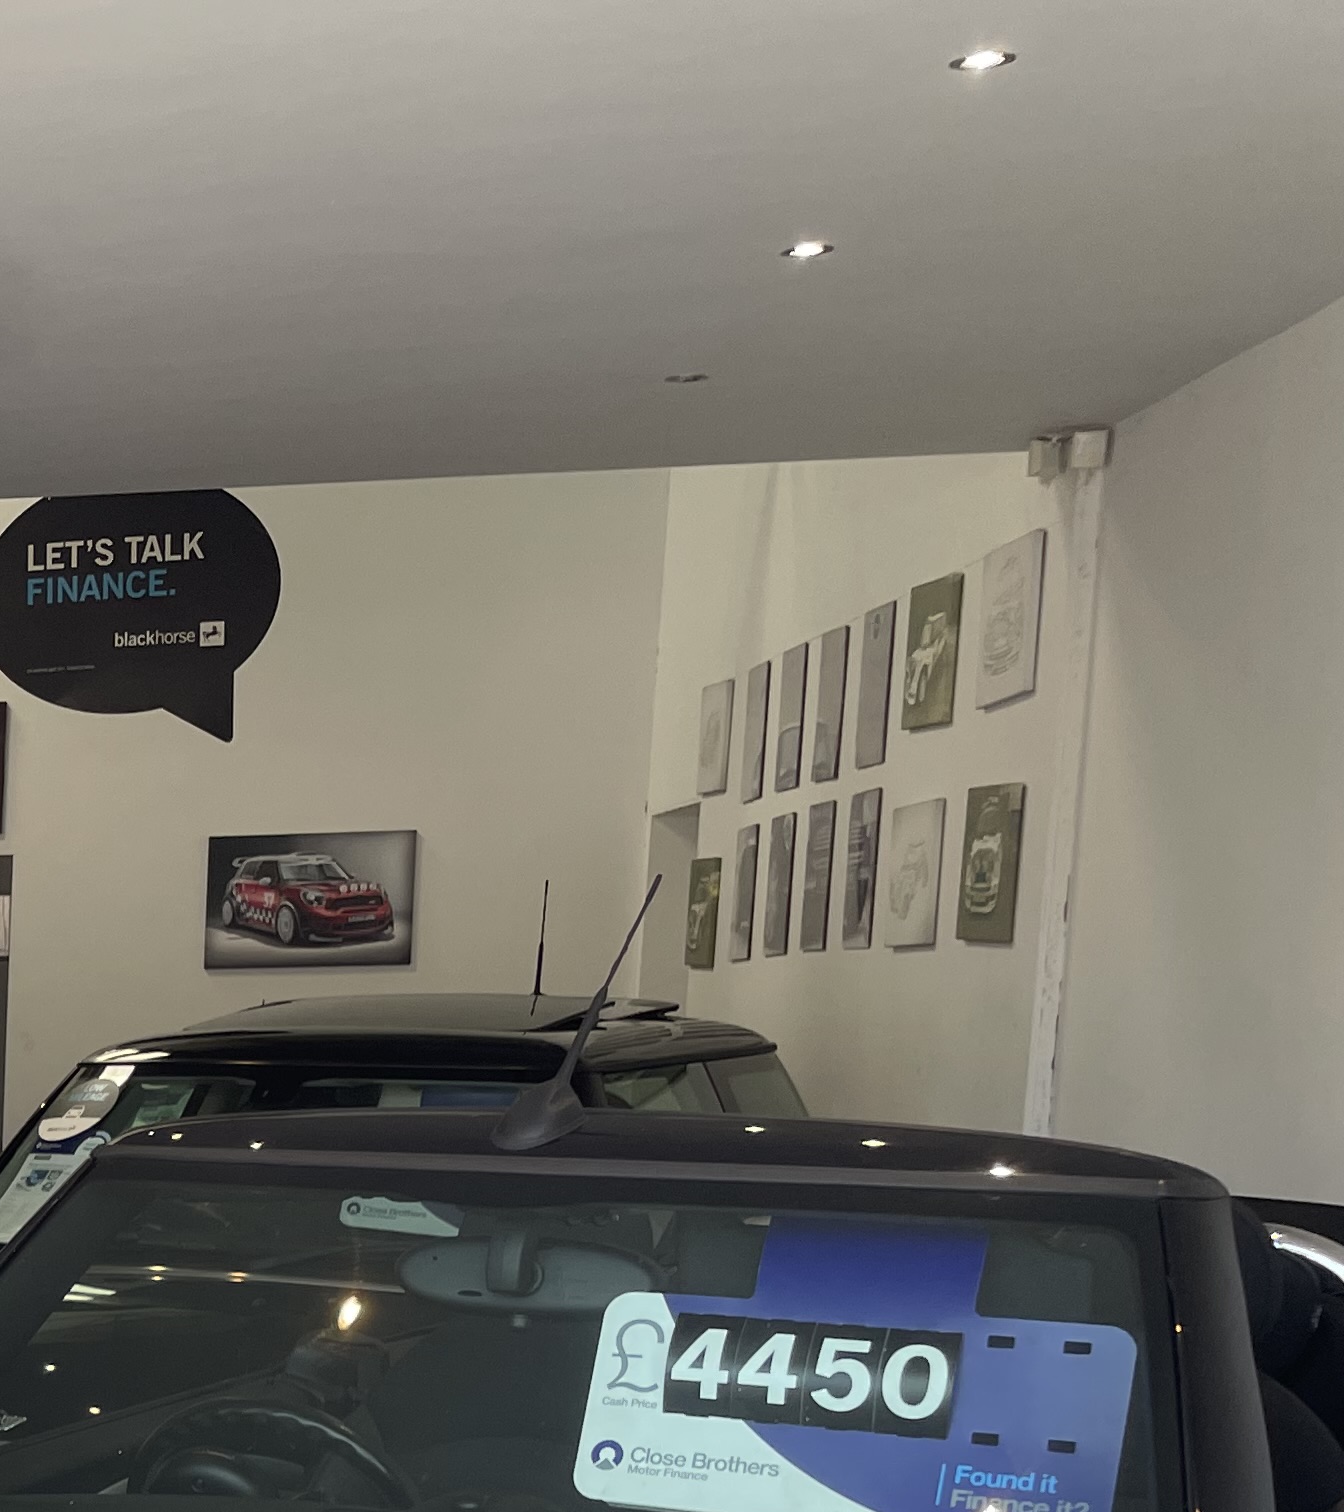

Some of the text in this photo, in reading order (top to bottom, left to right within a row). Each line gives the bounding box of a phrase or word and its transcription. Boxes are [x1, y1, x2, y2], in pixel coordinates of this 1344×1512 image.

[26, 531, 205, 572] LET'S TALK
[26, 568, 177, 606] FINANCE.
[114, 629, 196, 648] blackhorse
[670, 1327, 950, 1421] 4450
[602, 1396, 658, 1410] Cash Price
[627, 1464, 708, 1482] Motor Finance
[630, 1446, 780, 1478] Close Brothers
[954, 1464, 1059, 1494] Found it
